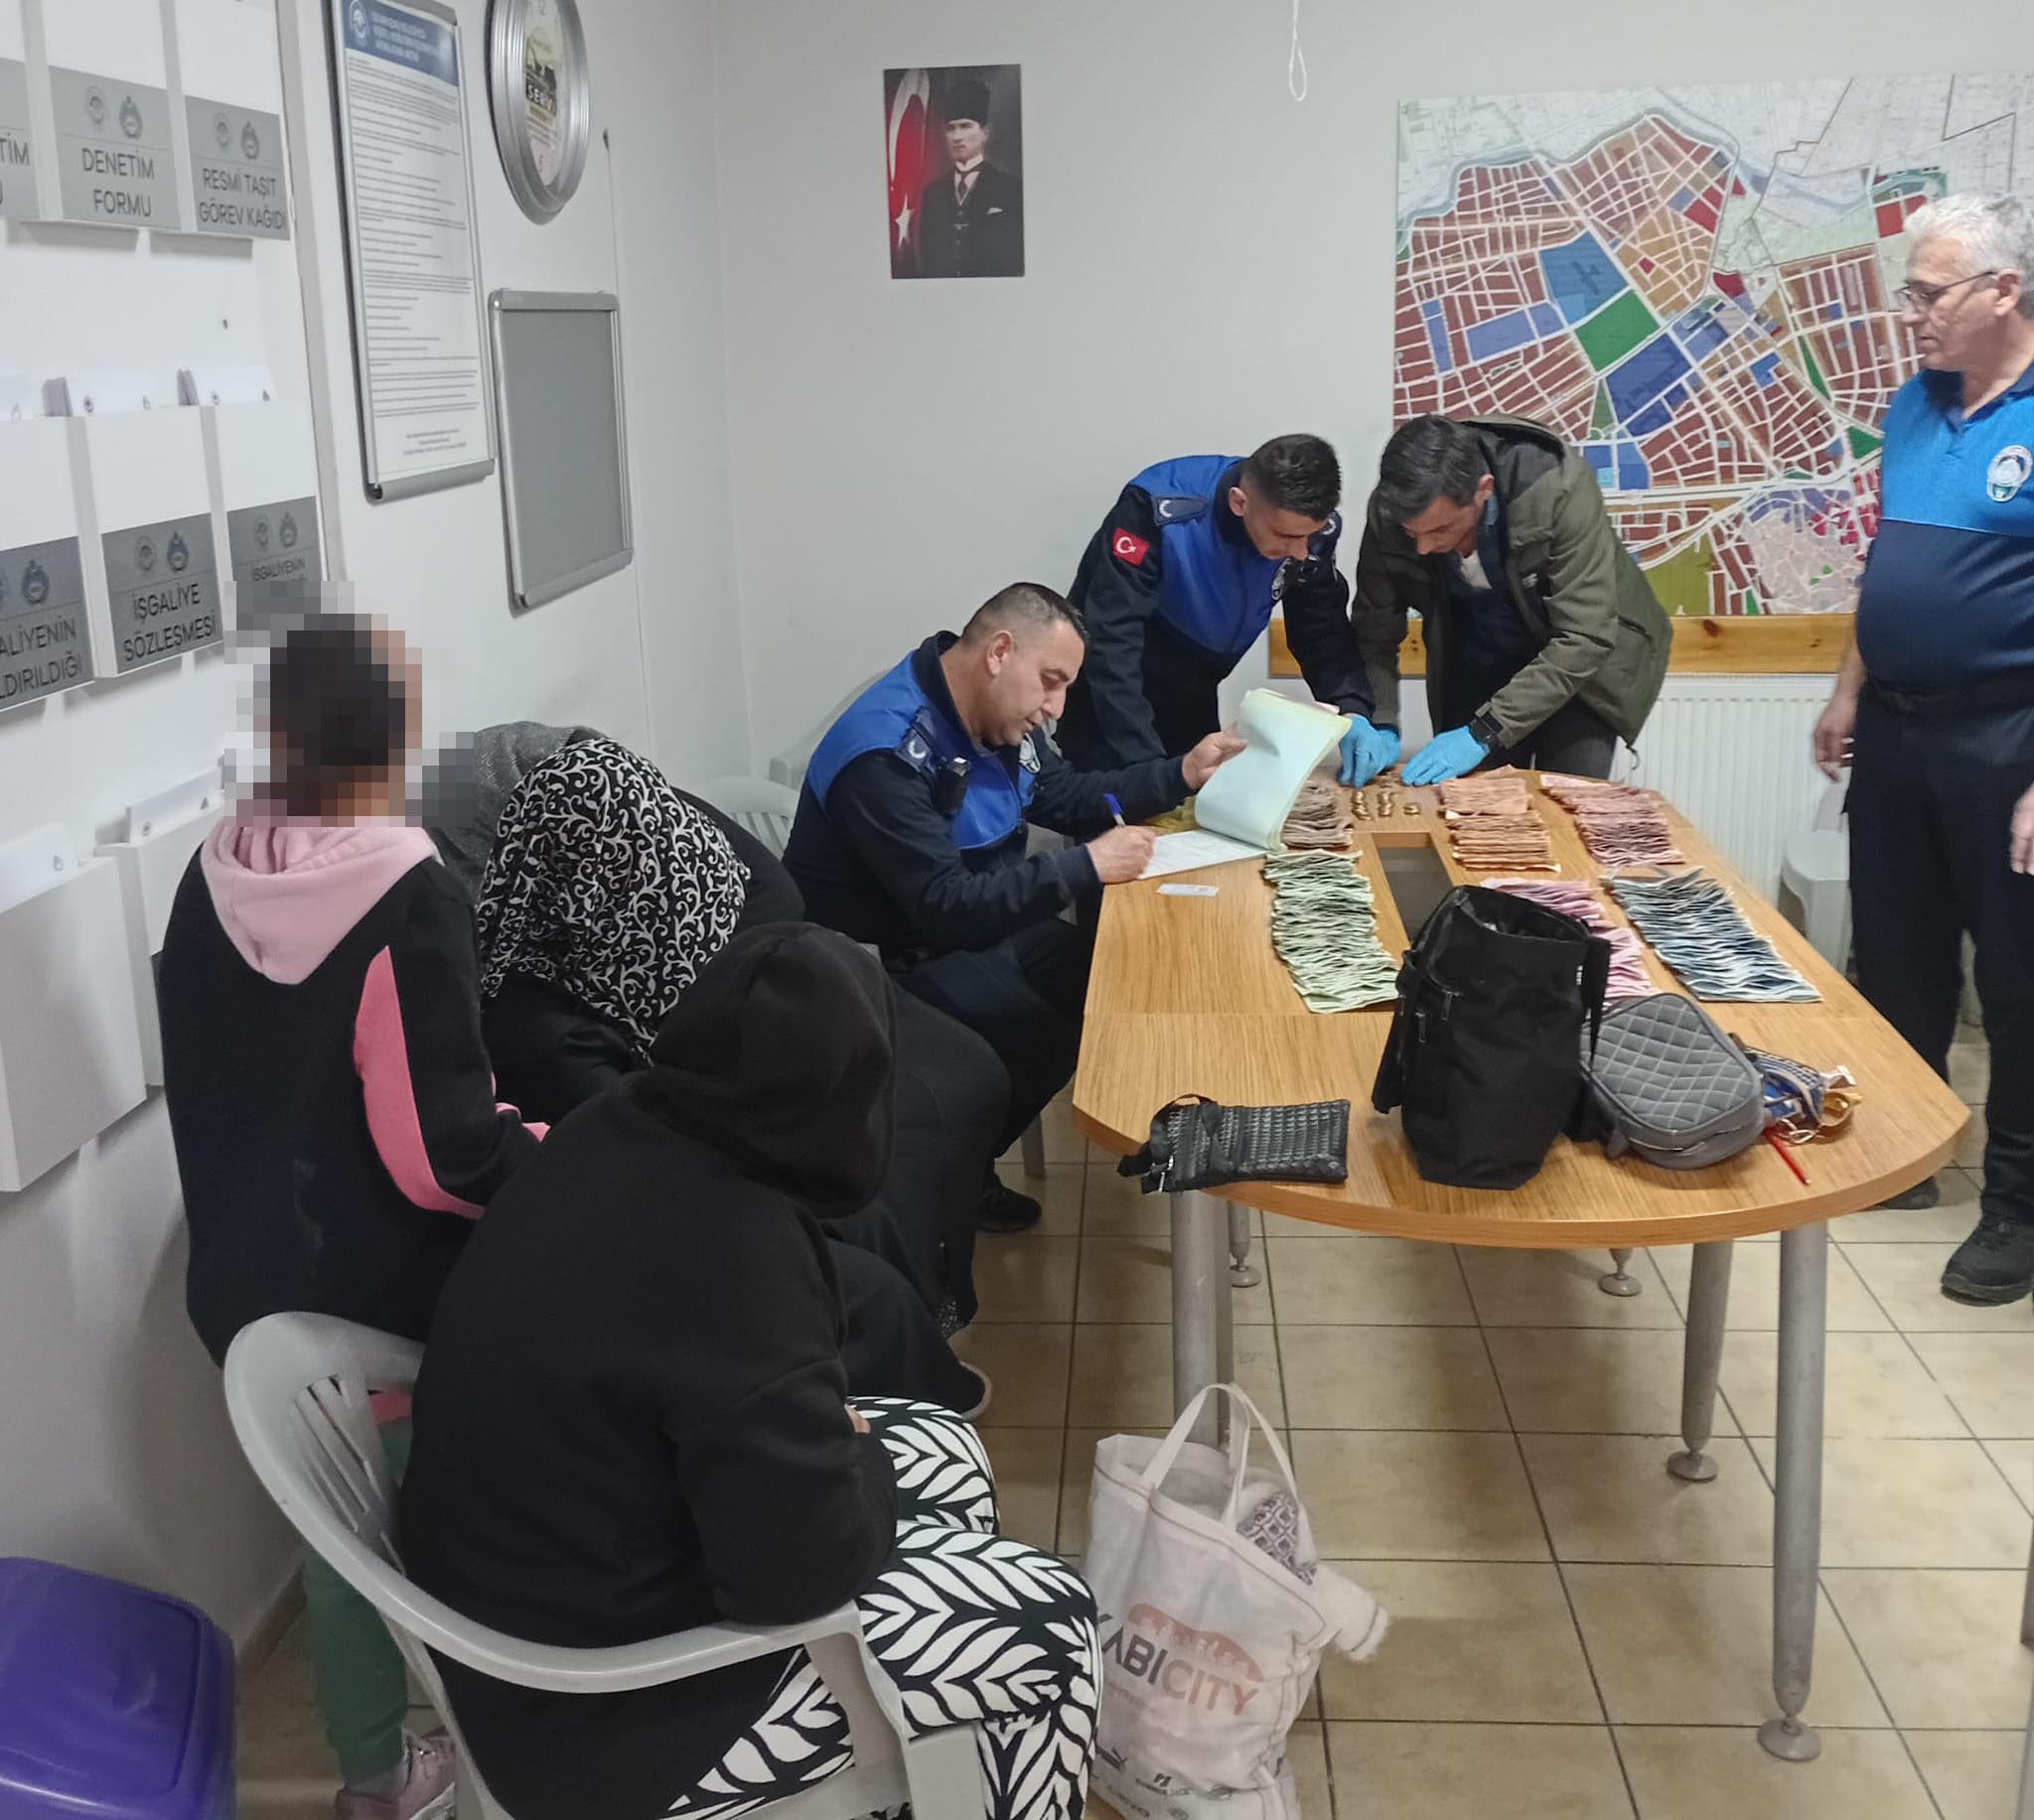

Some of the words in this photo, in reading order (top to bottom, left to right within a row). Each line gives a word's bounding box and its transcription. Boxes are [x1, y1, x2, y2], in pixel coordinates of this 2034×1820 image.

[81, 147, 155, 180] DENETİM
[203, 167, 242, 192] RESMİ
[244, 173, 277, 199] TAŞIT
[93, 189, 152, 216] FORMU
[199, 198, 244, 226] GÖREV
[132, 582, 201, 624] İŞGALİYE
[124, 609, 217, 661] SÖZLEŞMESİ
[0, 649, 82, 699] DIRILDIĞI
[1097, 1613, 1258, 1716] ABICITY
